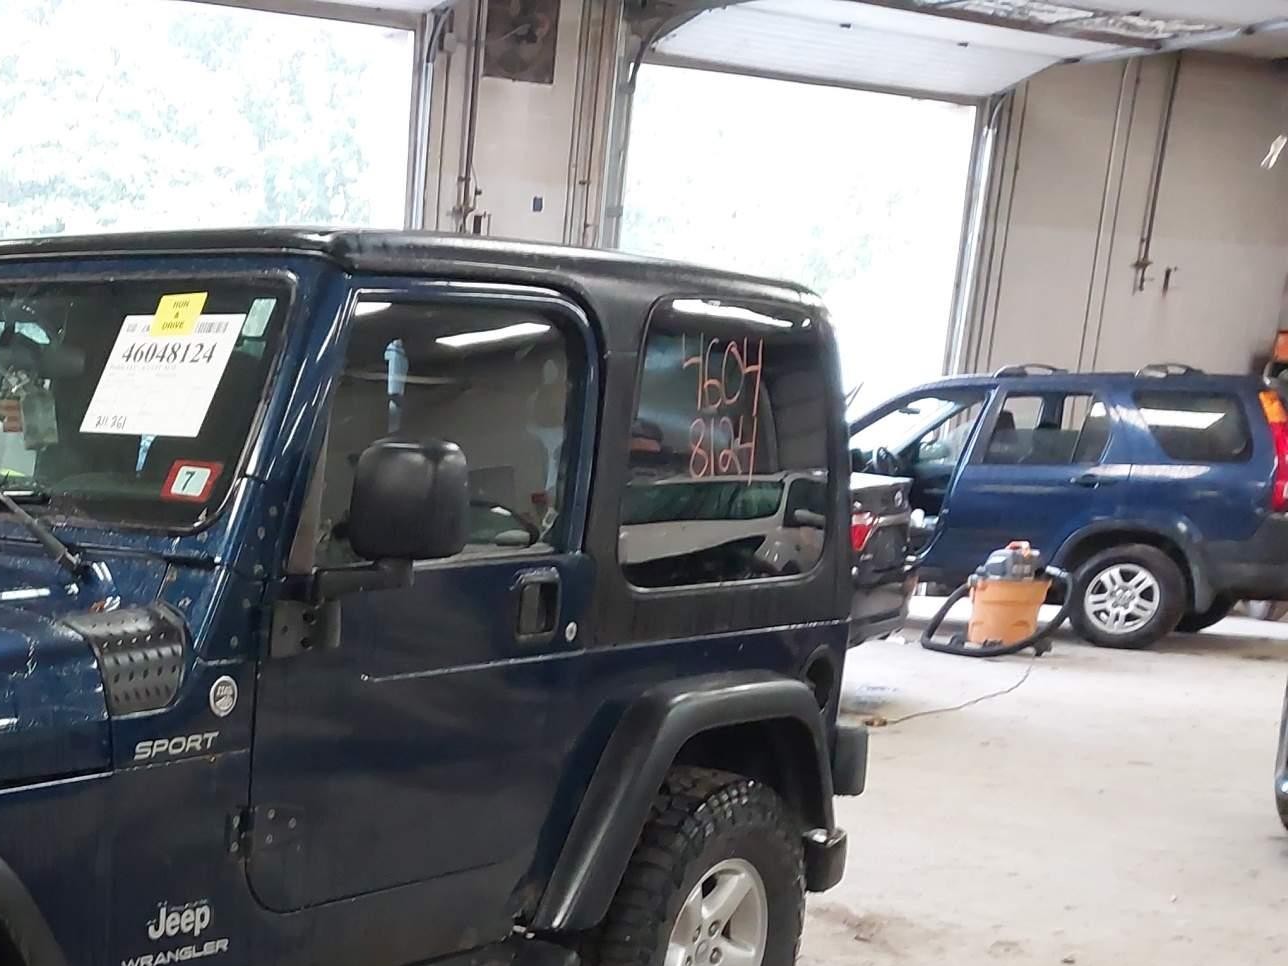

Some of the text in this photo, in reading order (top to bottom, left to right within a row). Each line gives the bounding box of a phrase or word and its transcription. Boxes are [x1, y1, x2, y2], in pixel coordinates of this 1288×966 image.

[161, 320, 185, 331] DRIVE
[121, 341, 217, 363] 46048124
[682, 332, 764, 417] 4604
[689, 416, 758, 487] 8124
[182, 470, 196, 492] 7
[133, 730, 220, 761] SPORT
[147, 900, 212, 941] Jeep
